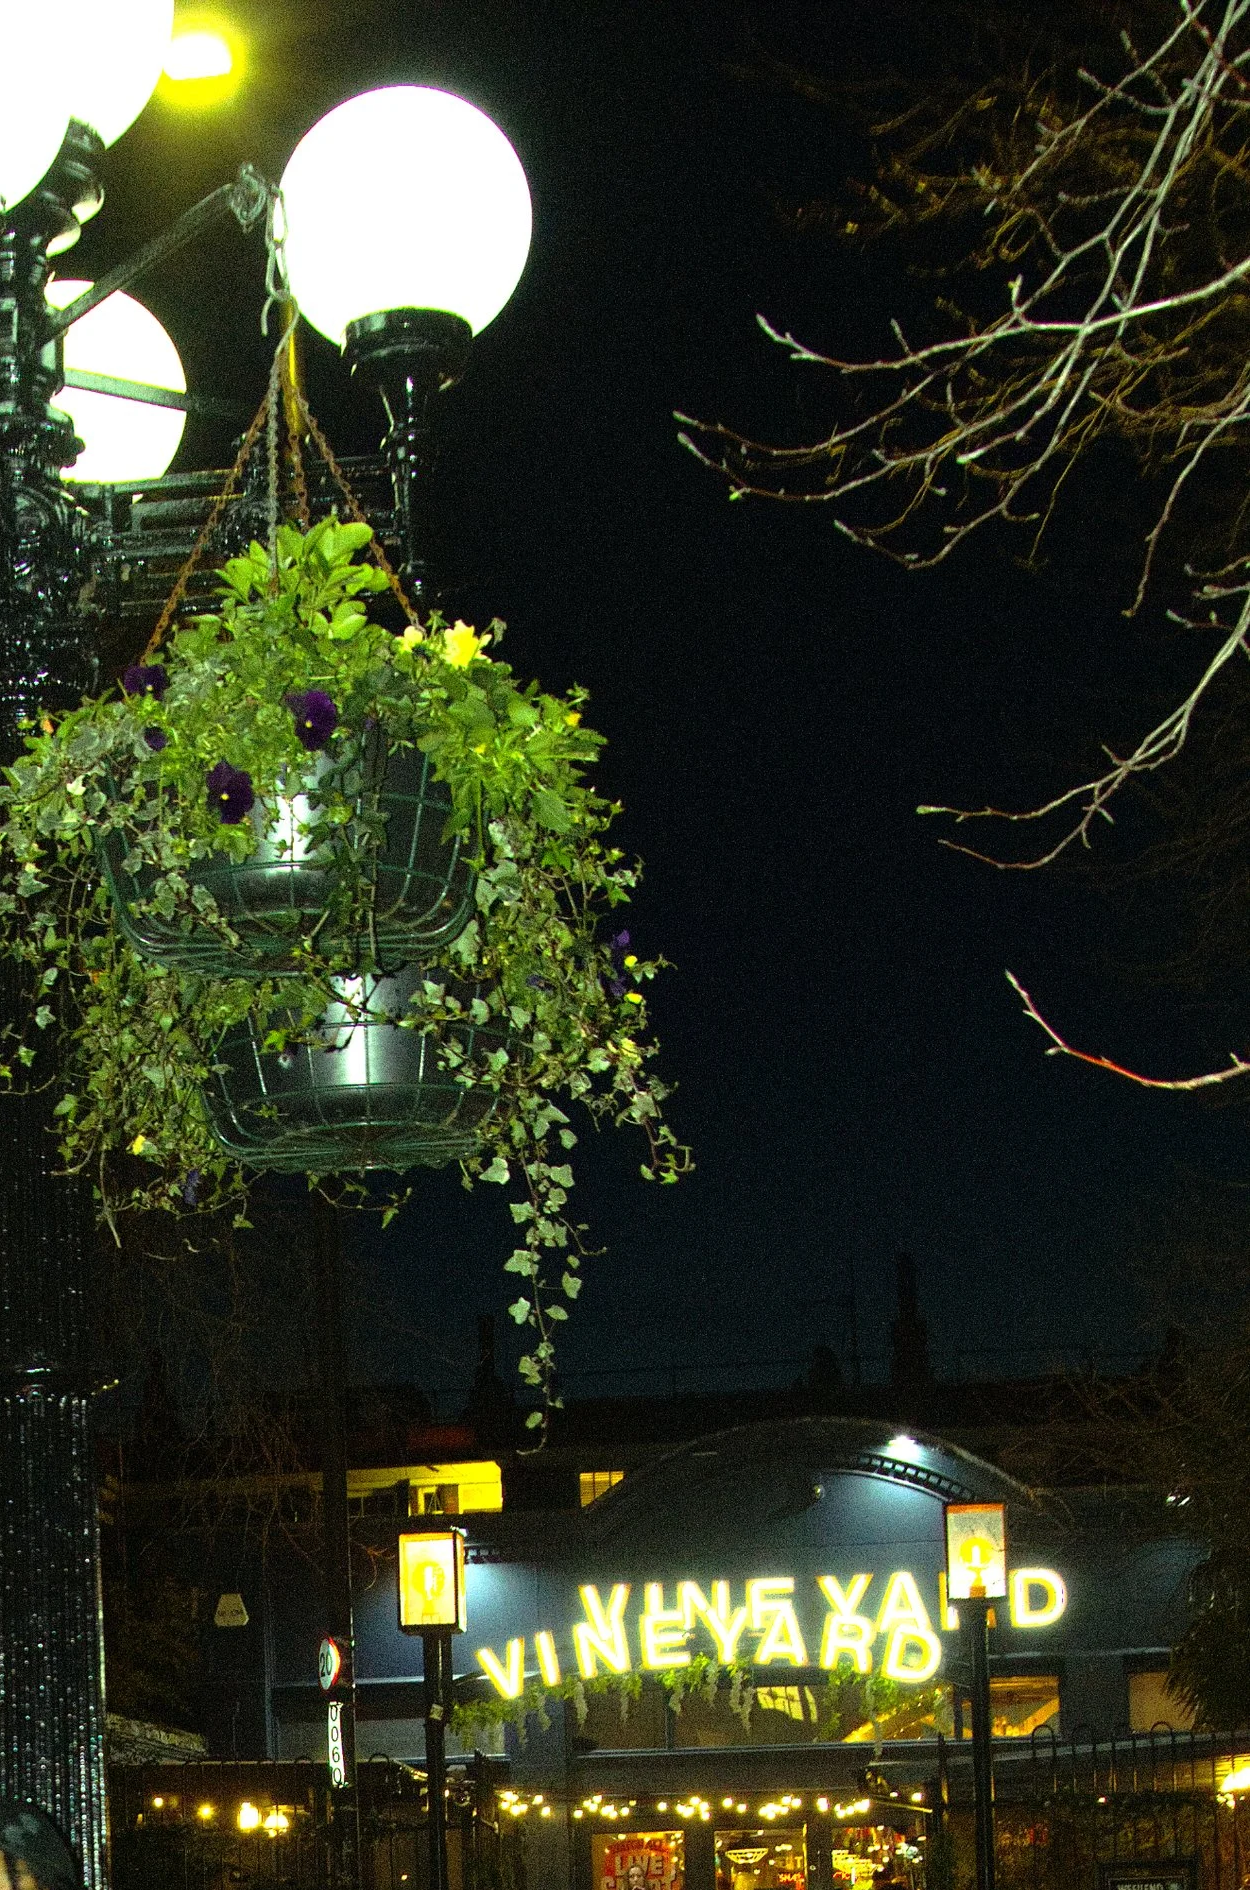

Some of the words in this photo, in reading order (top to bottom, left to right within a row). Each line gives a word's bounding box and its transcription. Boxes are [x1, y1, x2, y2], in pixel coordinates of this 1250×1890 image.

[579, 1568, 1066, 1640] VINEYAD
[319, 1652, 333, 1677] 20
[476, 1606, 942, 1699] VINEYARD
